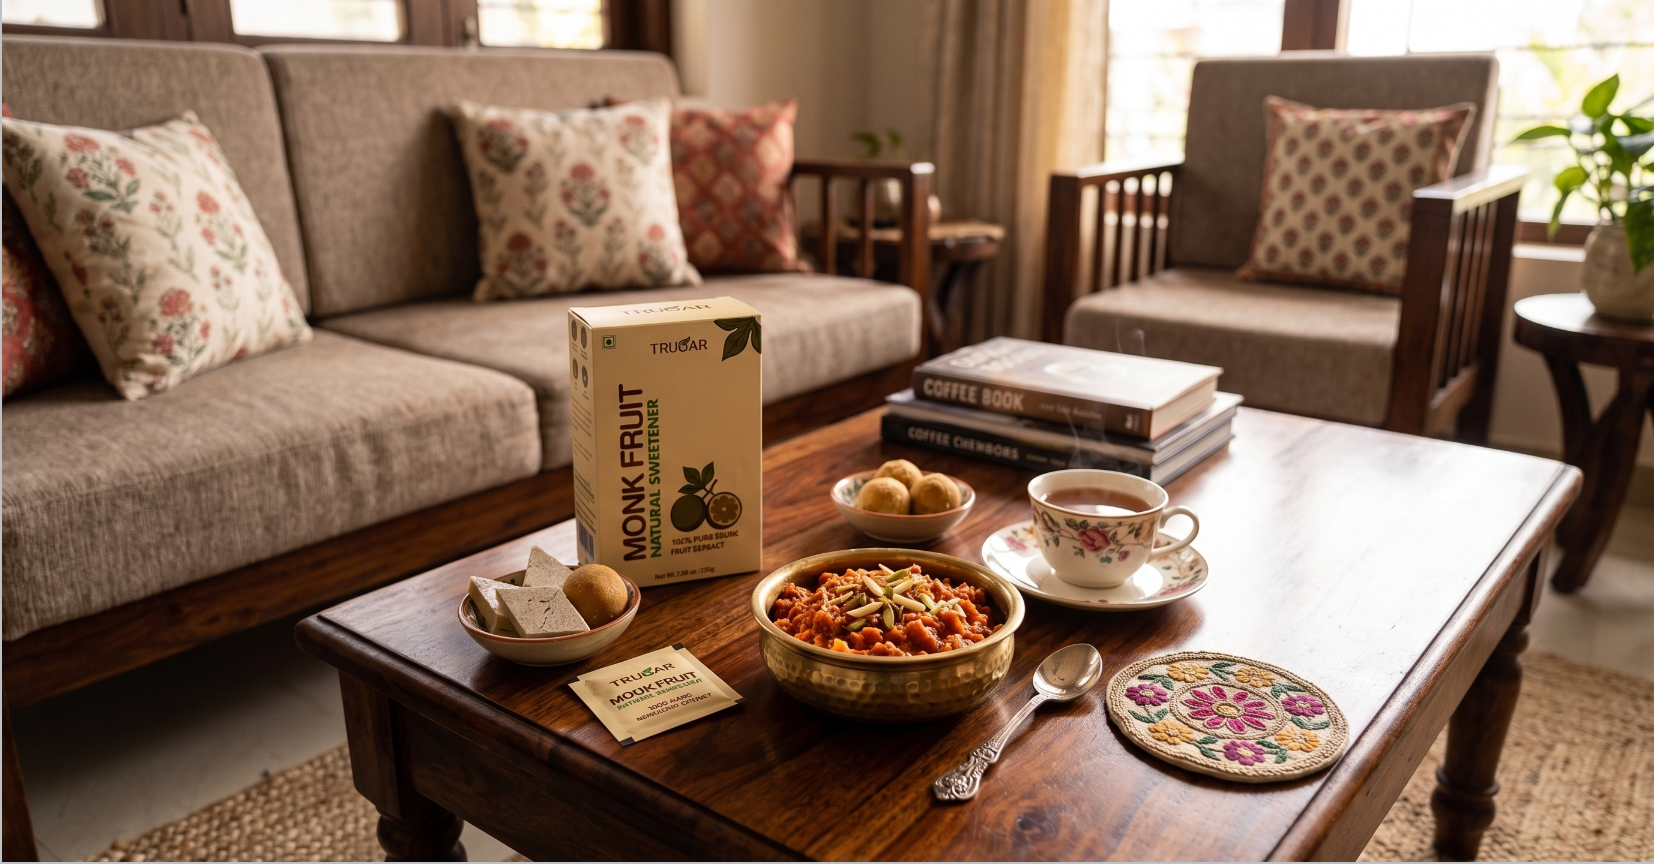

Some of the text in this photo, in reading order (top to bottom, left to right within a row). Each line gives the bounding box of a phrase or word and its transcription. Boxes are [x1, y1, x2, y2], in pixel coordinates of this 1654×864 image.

[923, 377, 979, 404] COFFEE
[981, 387, 1025, 412] BOOK
[907, 426, 951, 447] COFFEE
[618, 383, 647, 562] MONK FRUIT
[647, 398, 662, 558] NATURAL SWEETENER
[670, 546, 692, 556] FRUIT
[654, 671, 698, 688] FRUIT
